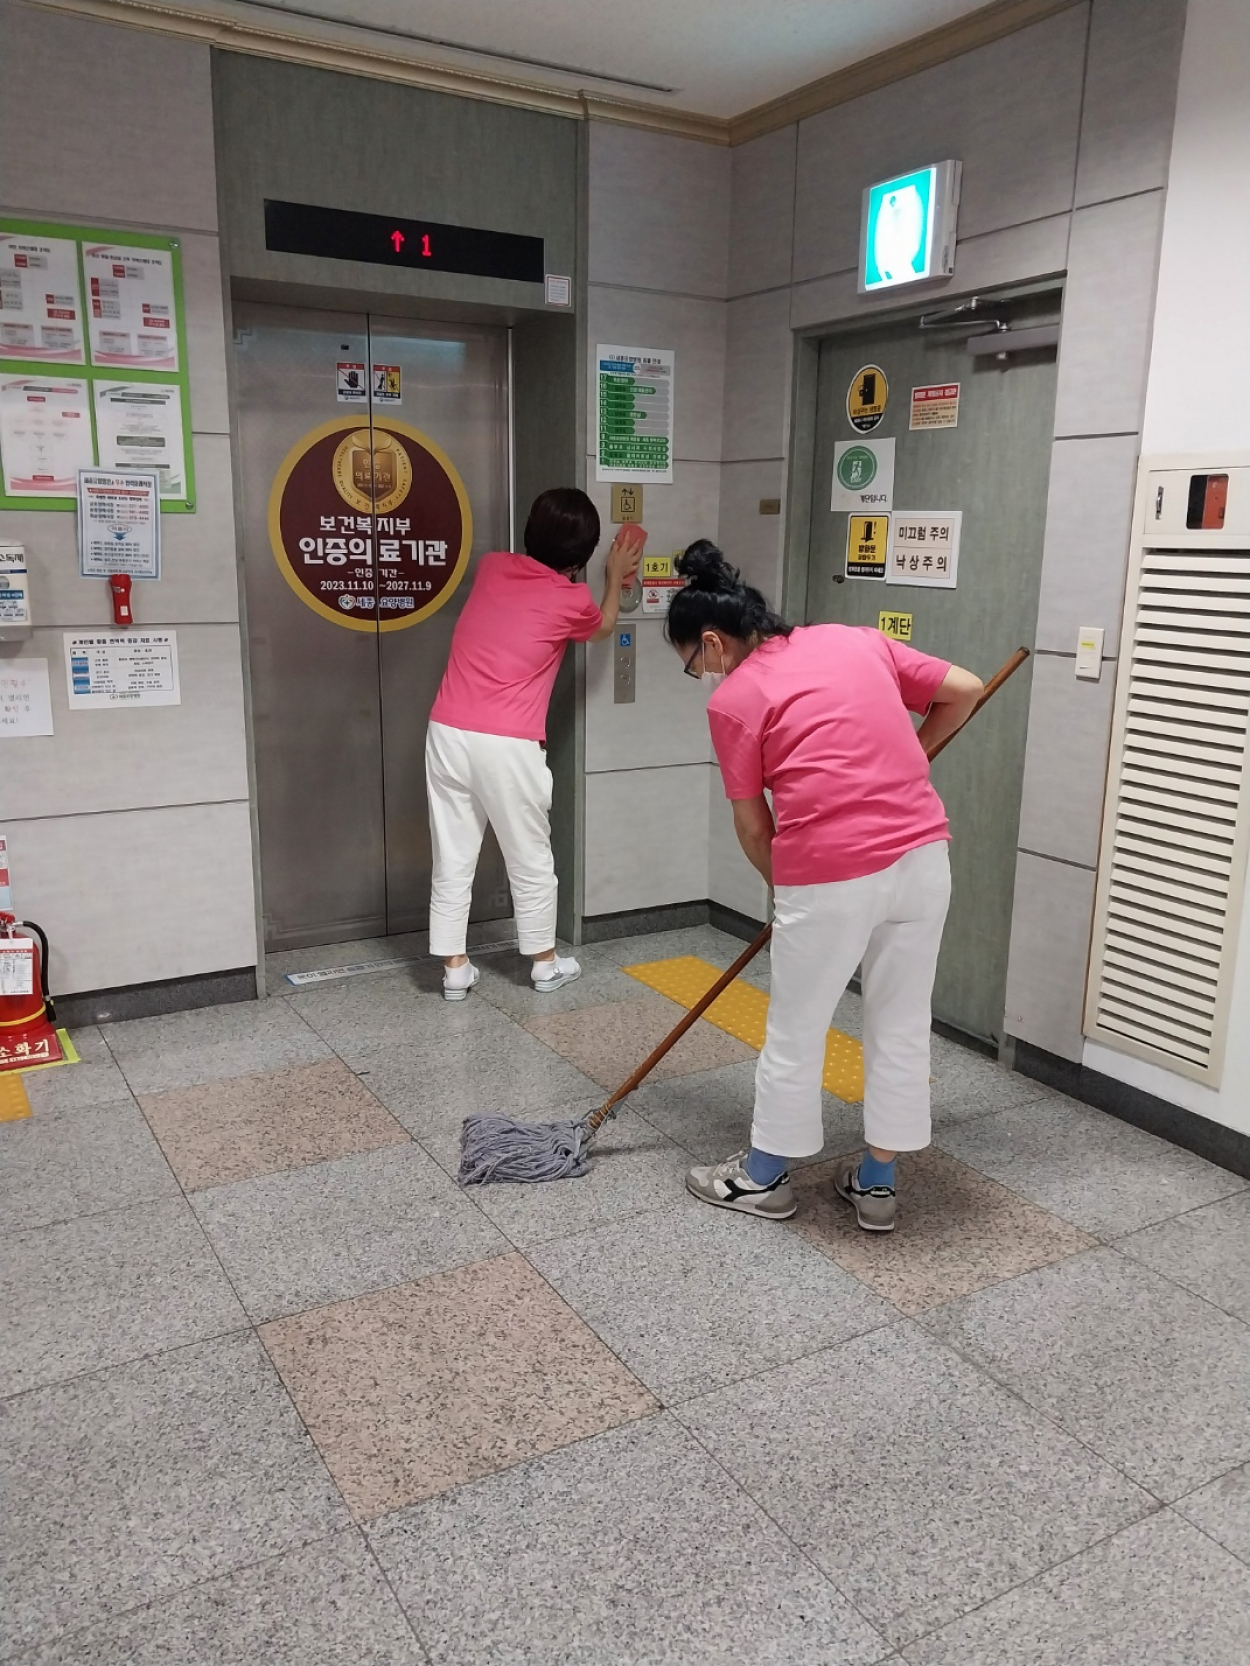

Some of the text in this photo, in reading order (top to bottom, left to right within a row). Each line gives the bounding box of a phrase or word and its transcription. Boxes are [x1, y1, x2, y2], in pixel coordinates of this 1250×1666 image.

[422, 234, 432, 257] 1
[319, 516, 412, 536] 보건복지부
[898, 525, 949, 542] 미끄럼 주의
[298, 537, 449, 567] 인증의료기관
[645, 562, 669, 573] 1호기
[880, 616, 911, 636] 1계단
